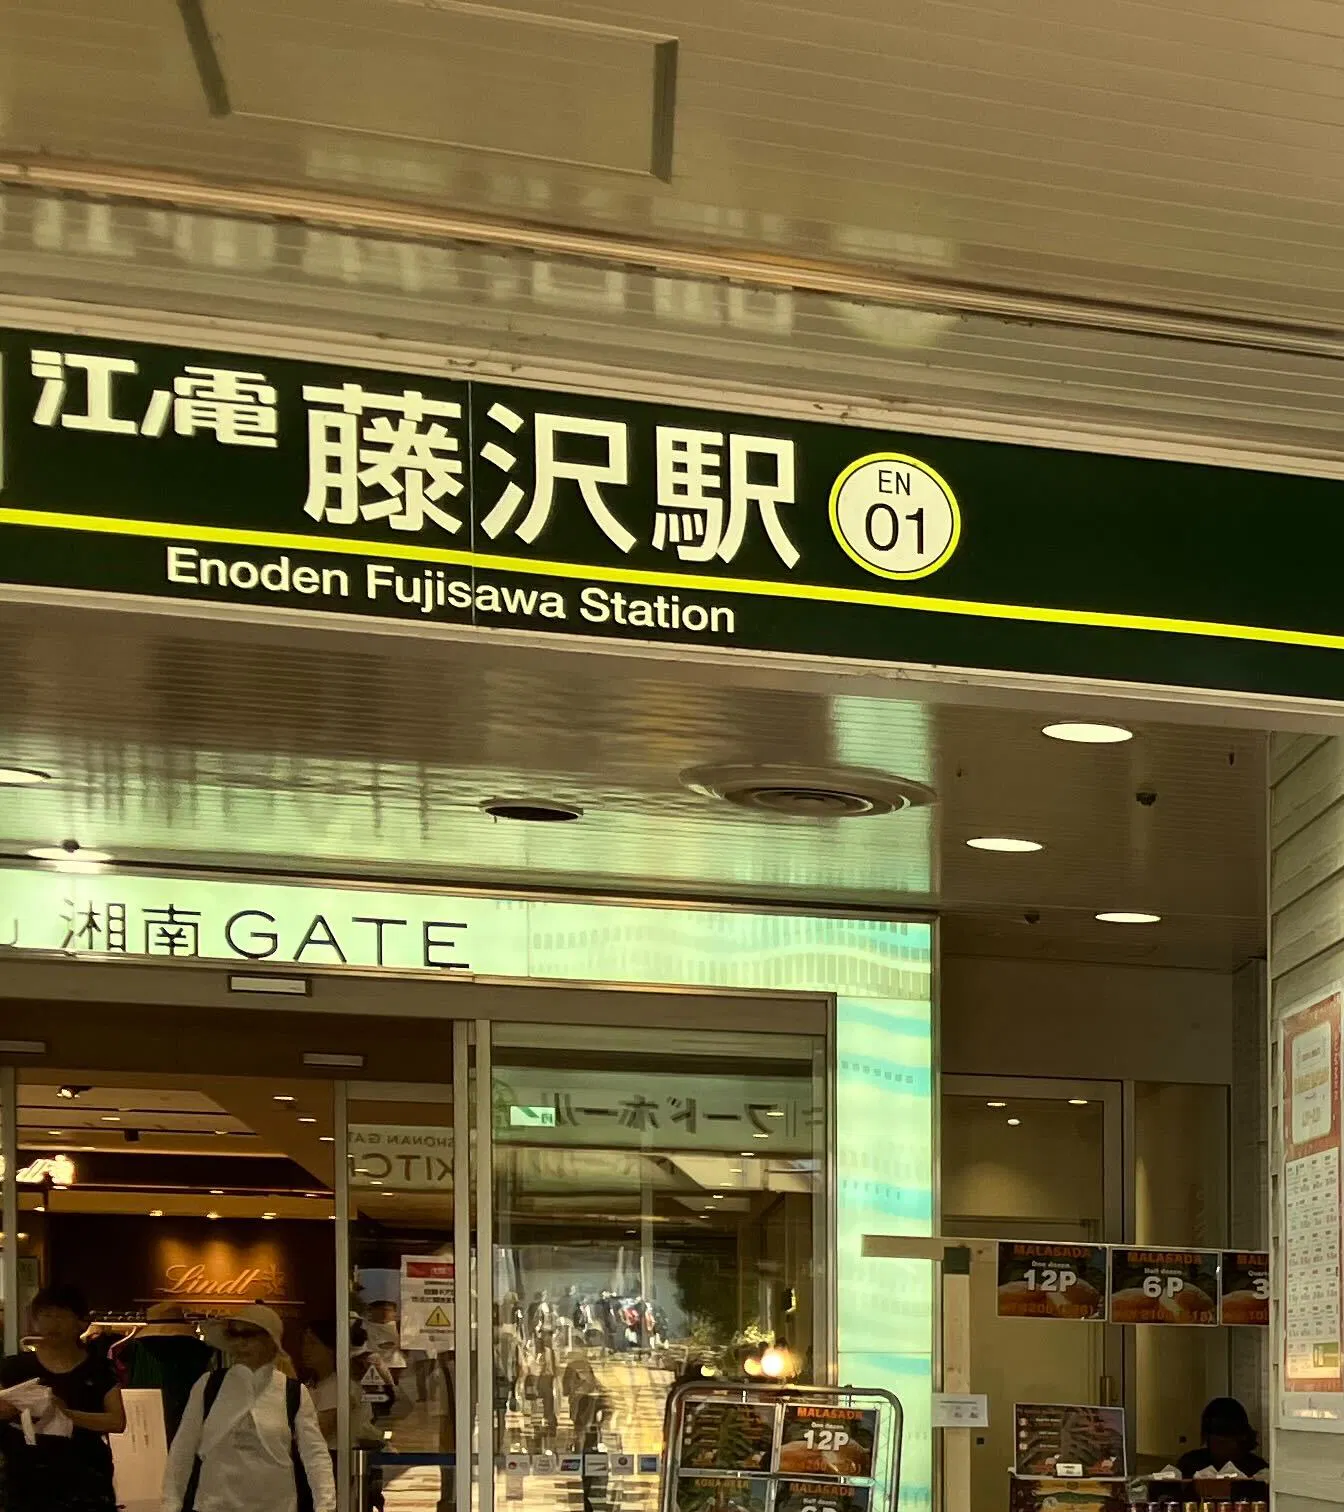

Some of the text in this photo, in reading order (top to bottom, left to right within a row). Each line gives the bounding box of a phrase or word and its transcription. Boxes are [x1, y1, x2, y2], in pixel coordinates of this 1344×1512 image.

[302, 384, 801, 569] 藤沢駅
[878, 469, 912, 497] EN
[864, 502, 926, 556] 01
[167, 546, 735, 634] Enoden Fujisawa Station
[61, 899, 201, 958] 湘南
[225, 910, 470, 968] GATE
[154, 1264, 261, 1295] Lindt
[1023, 1269, 1078, 1293] 12P
[1143, 1276, 1184, 1299] 6P
[803, 1429, 849, 1451] 12P
